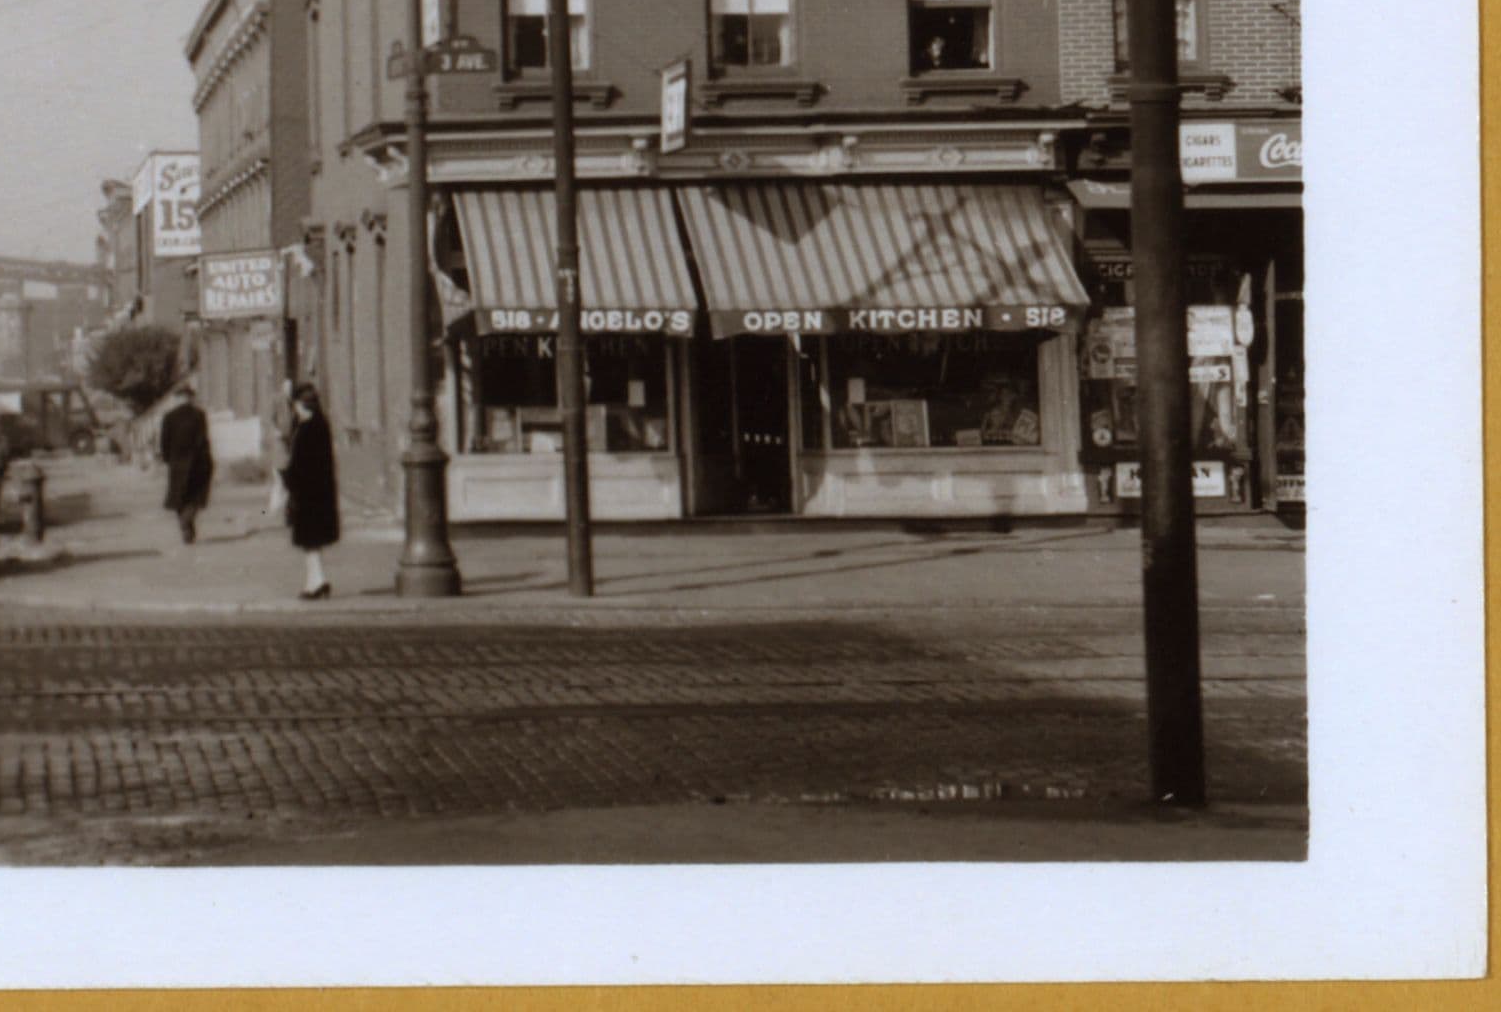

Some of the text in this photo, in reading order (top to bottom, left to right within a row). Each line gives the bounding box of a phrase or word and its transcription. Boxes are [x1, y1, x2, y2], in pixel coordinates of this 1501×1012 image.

[440, 53, 452, 71] 3
[1185, 135, 1221, 147] CIGARS
[1182, 155, 1234, 169] IGARETTES
[207, 257, 272, 275] UNITED
[211, 272, 267, 290] AUTO
[205, 285, 276, 311] REPAIRS
[743, 310, 823, 332] OPEN
[848, 308, 984, 330] KITCHEN
